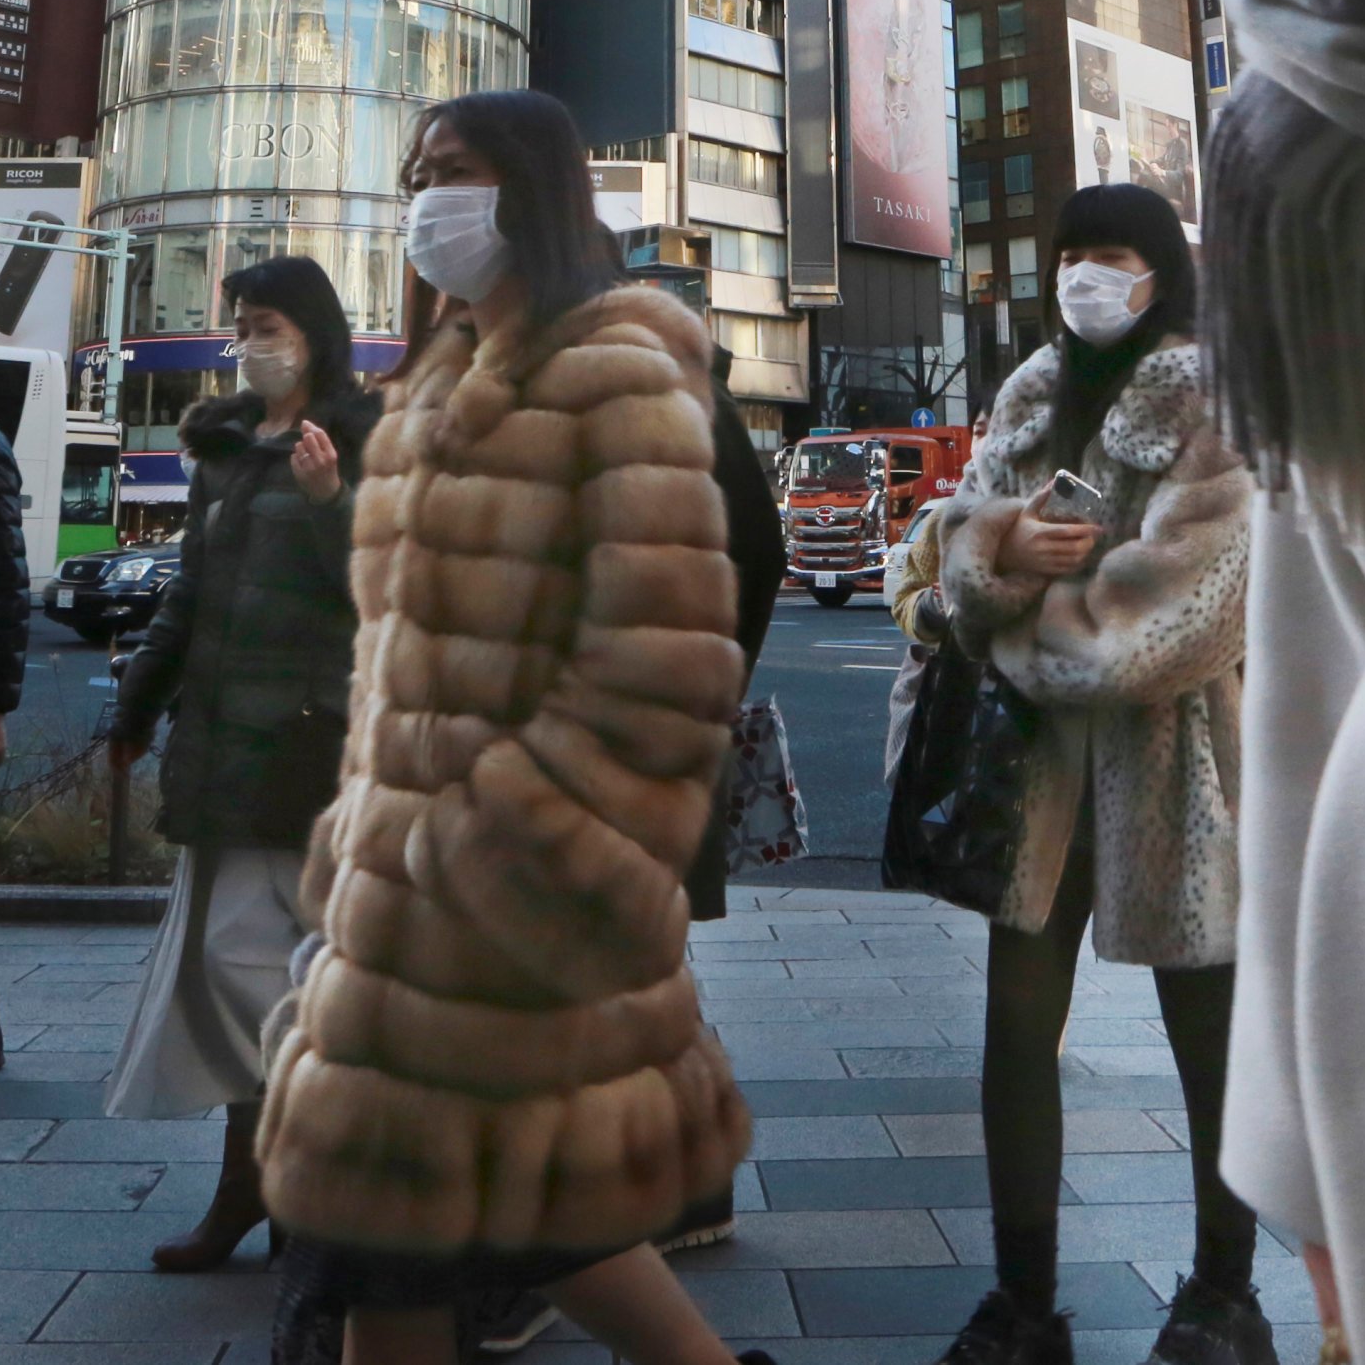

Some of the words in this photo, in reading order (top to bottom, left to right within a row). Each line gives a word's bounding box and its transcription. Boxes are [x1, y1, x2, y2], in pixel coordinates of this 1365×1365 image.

[6, 169, 44, 178] RICOH
[123, 208, 160, 226] San-ai
[873, 196, 931, 223] TASAKI
